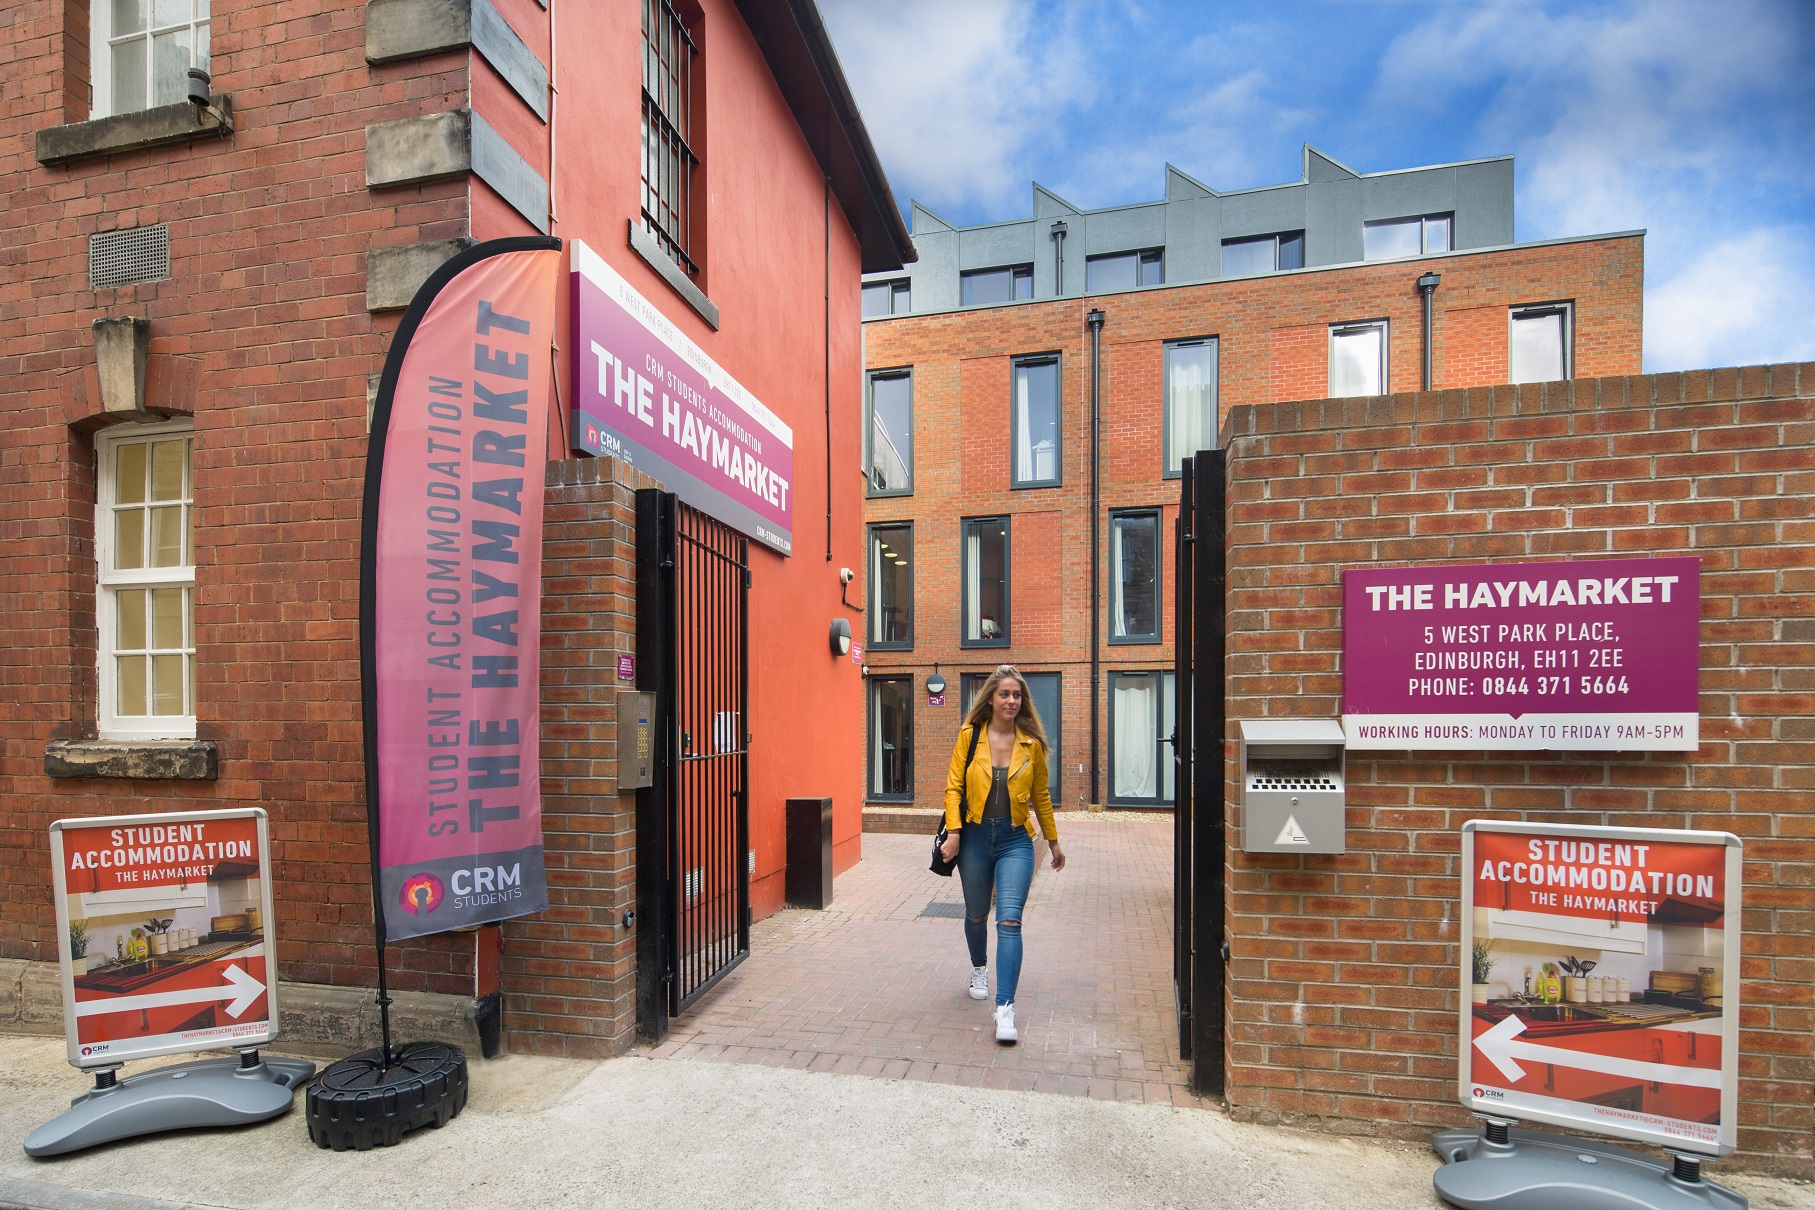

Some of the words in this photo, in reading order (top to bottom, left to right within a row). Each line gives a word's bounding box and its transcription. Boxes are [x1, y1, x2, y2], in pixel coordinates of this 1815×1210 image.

[625, 289, 640, 312] WEST
[642, 305, 657, 328] PARK
[657, 319, 673, 341] PLACE
[645, 353, 664, 382] CRM
[667, 370, 707, 414] STUDENTS
[709, 404, 762, 455] ACCOMMODATION
[590, 339, 654, 428] THE
[662, 392, 789, 512] HAYMARKET
[600, 430, 621, 454] CRM
[471, 300, 530, 689] HAYMARKET
[426, 375, 463, 671] ACCOMMODATION
[1365, 584, 1434, 611] THE
[1444, 575, 1679, 609] HAYMARKET
[1424, 626, 1434, 644] 5
[1441, 625, 1491, 644] WEST
[1498, 623, 1547, 642] PARK
[1555, 621, 1620, 642] PLACE,
[1415, 651, 1525, 670] EDINBURGH,
[1534, 649, 1579, 668] EH11
[1589, 648, 1623, 667] 2EE
[1408, 677, 1474, 696] PHONE:
[1482, 677, 1529, 695] 0844
[1537, 676, 1570, 695] 371
[1580, 675, 1630, 694] 5664
[1358, 725, 1419, 739] WORKING
[1424, 725, 1473, 739] HOURS:
[1479, 725, 1535, 739] MONDAY
[1539, 725, 1556, 739] TO
[1562, 725, 1611, 739] FRIDAY
[1616, 725, 1684, 739] 9AM-5PM
[427, 687, 462, 838] STUDENT
[467, 718, 520, 834] THE
[111, 823, 205, 847] STUDENT
[71, 839, 252, 870] ACCOMMODATION
[1528, 839, 1650, 868] STUDENT
[115, 870, 139, 883] THE
[143, 864, 214, 881] HAYMARKET
[451, 862, 521, 896] CRM
[1479, 860, 1714, 898] ACCOMMODATION
[454, 887, 522, 909] STUDENTS
[1530, 891, 1558, 907] THE
[1563, 894, 1658, 915] HAYMARKET
[92, 1044, 109, 1052] CRM
[1485, 1089, 1504, 1099] CRM
[1593, 1107, 1718, 1135] THEHAYMARKET@CRM-STUDENTS.COM
[1663, 1127, 1681, 1135] 0844
[1683, 1130, 1695, 1138] 371
